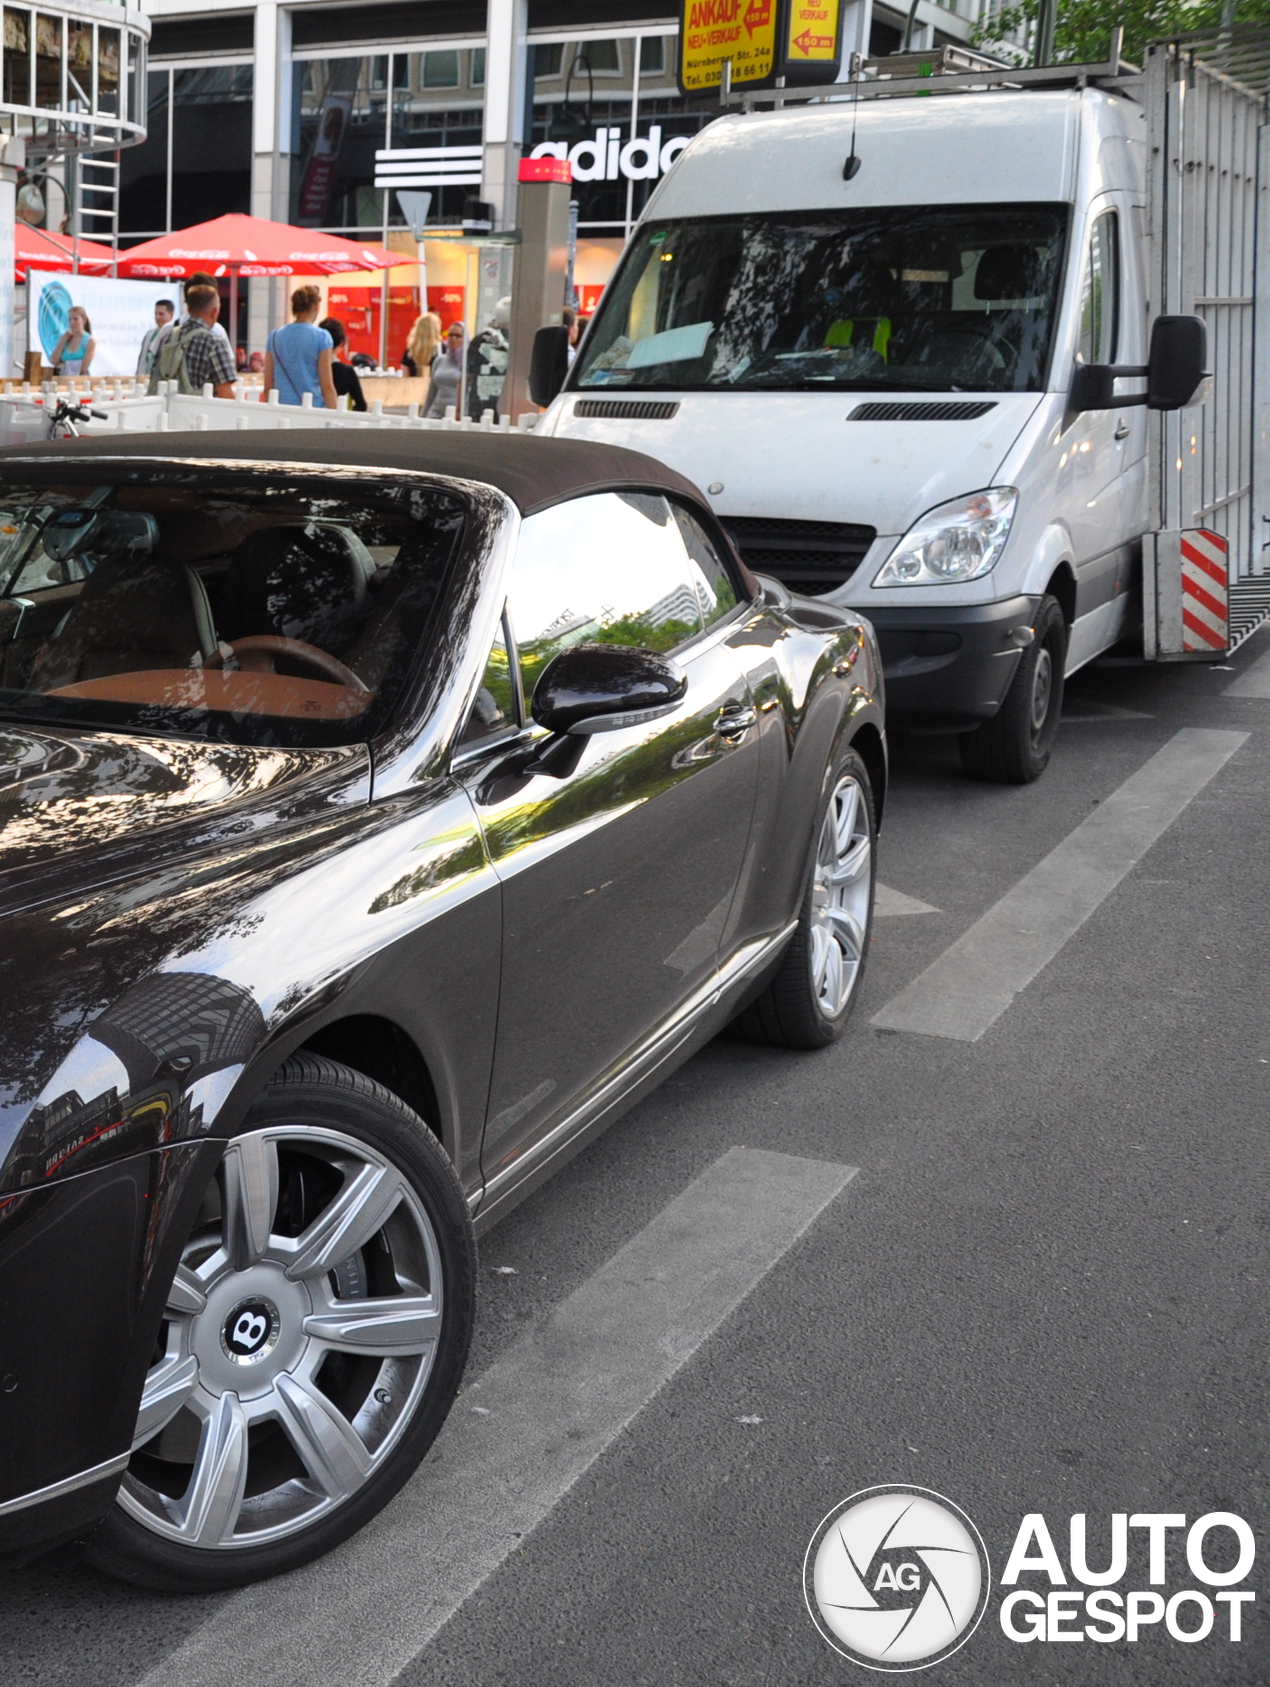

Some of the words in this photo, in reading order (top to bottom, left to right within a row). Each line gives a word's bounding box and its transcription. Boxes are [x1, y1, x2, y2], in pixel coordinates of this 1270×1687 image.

[797, 37, 818, 46] 150
[737, 50, 751, 60] Str.
[686, 75, 702, 85] Tel.
[759, 62, 770, 73] 11
[232, 1311, 267, 1349] B
